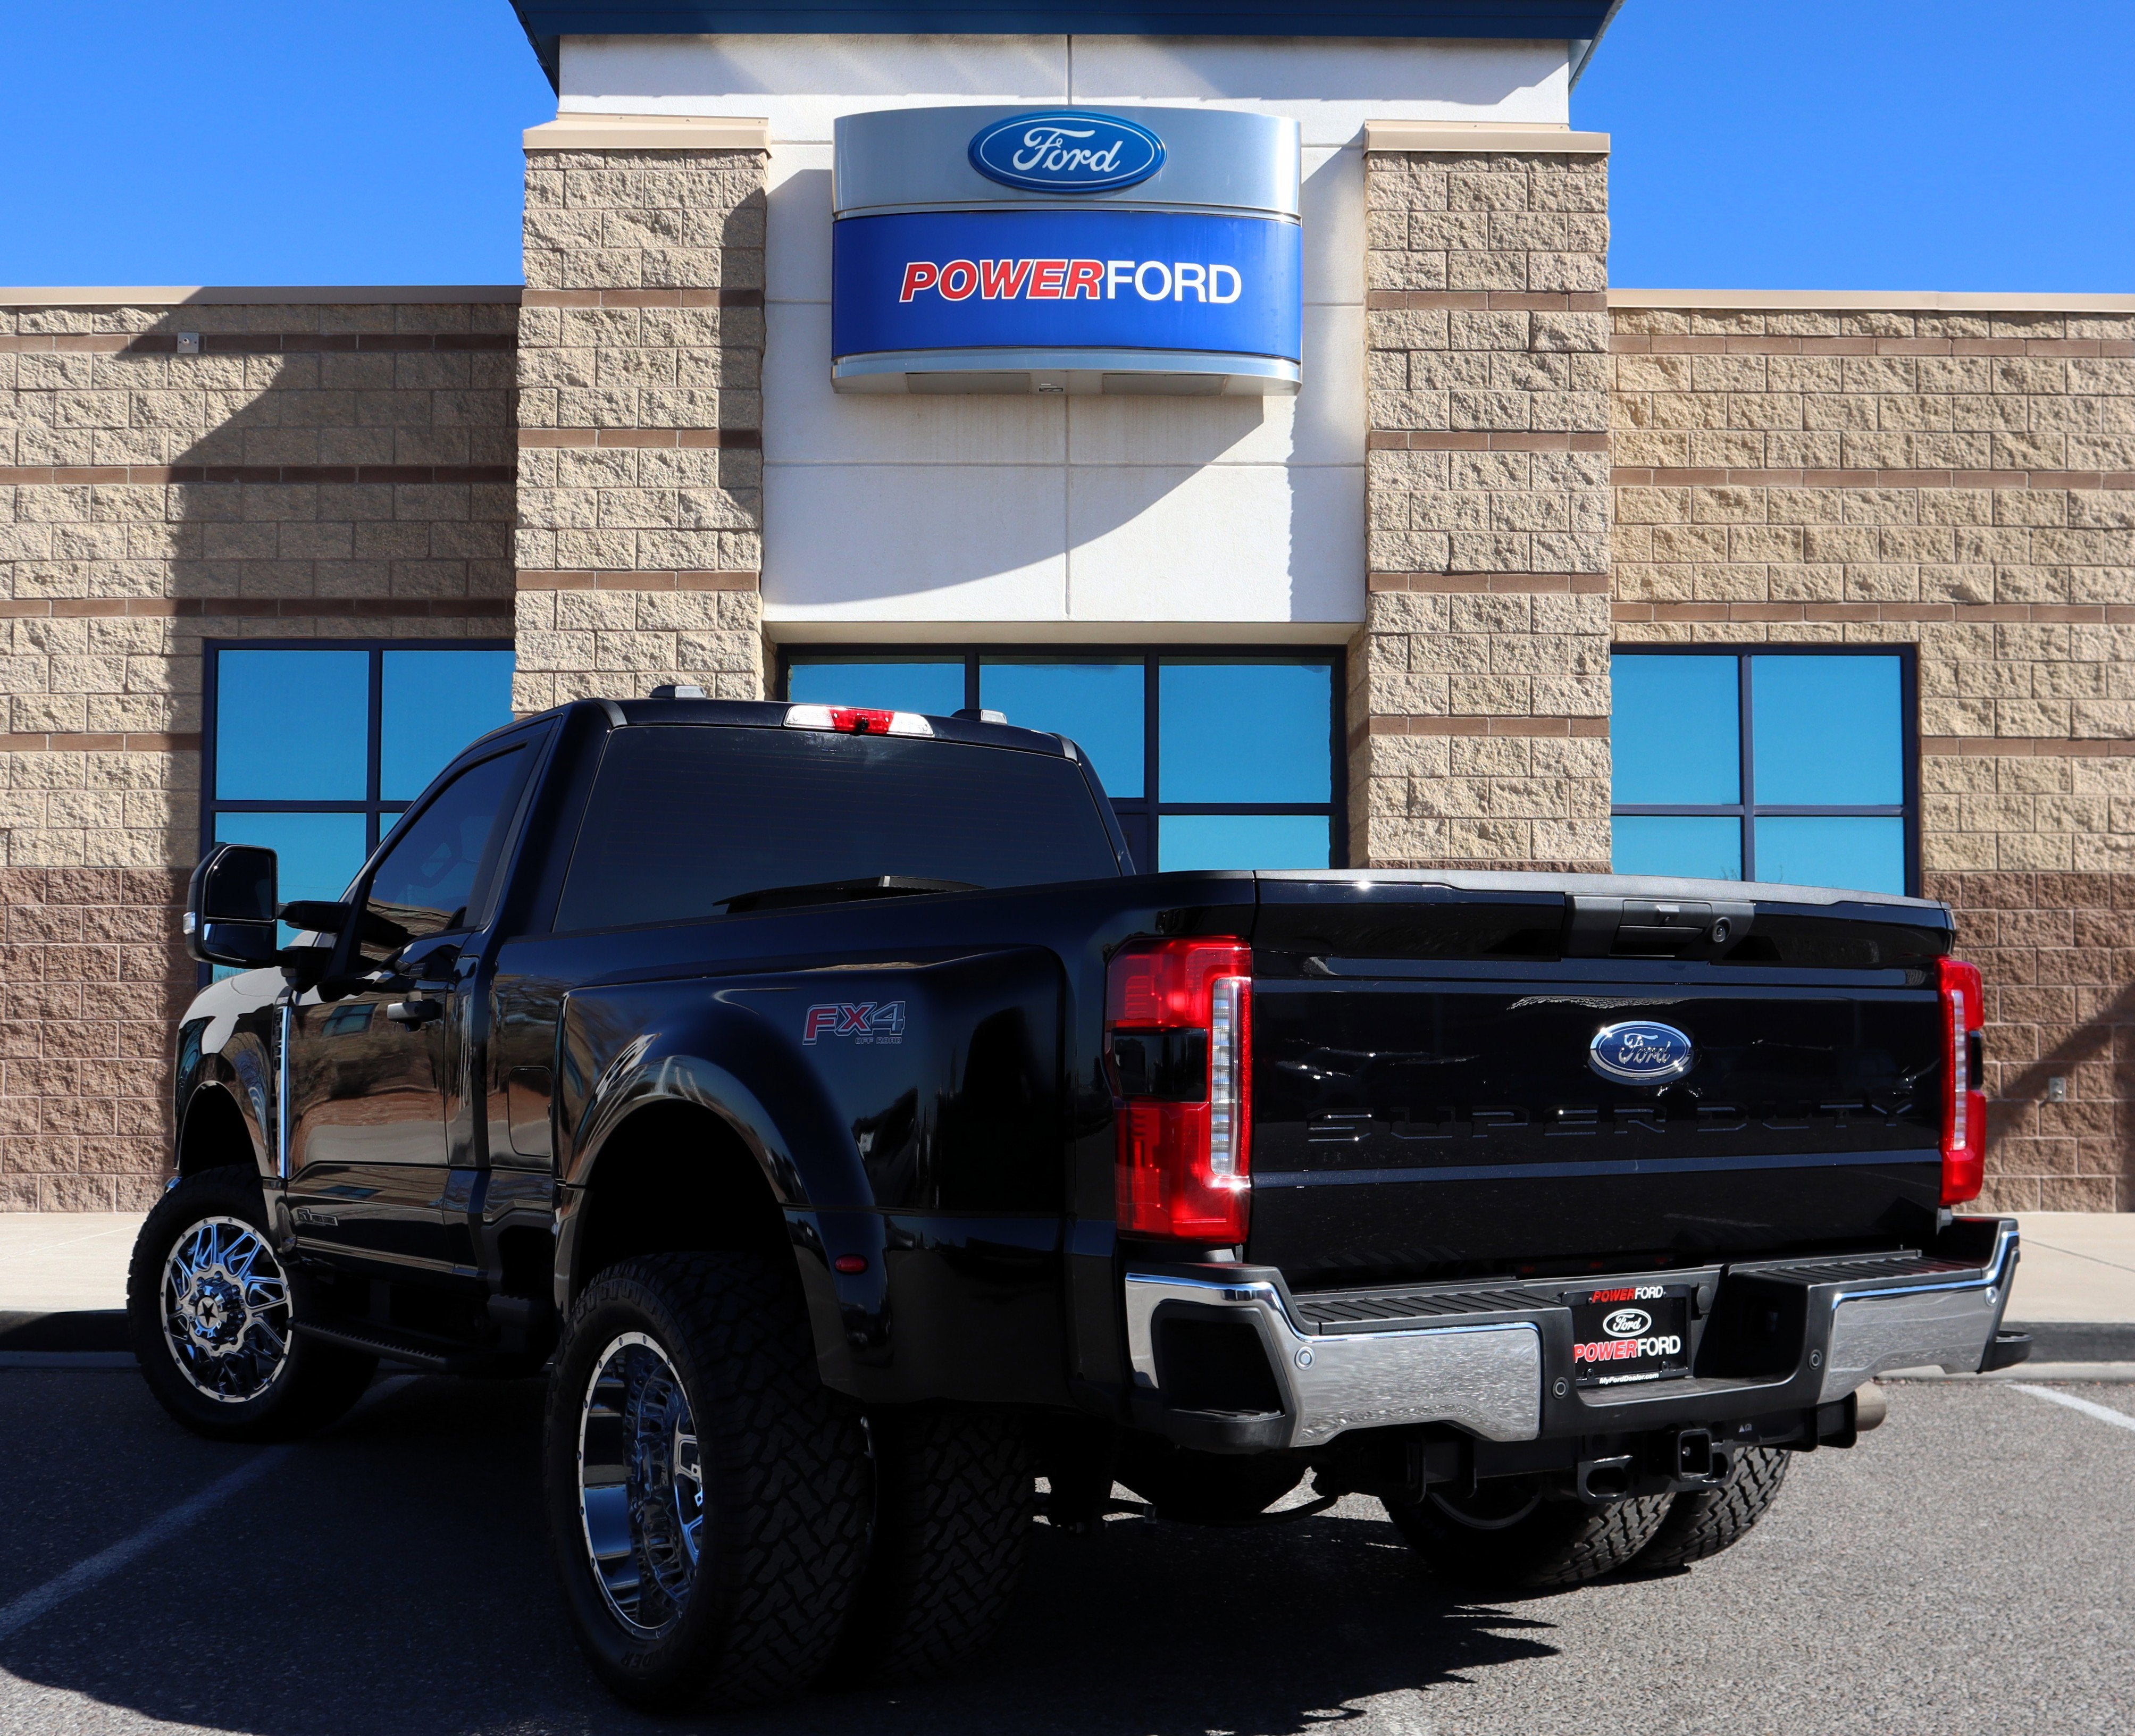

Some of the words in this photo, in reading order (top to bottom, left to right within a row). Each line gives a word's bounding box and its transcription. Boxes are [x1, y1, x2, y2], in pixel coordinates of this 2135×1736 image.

[1012, 127, 1123, 173] Ford
[802, 1001, 906, 1045] FX4
[1618, 1033, 1671, 1064] Ford
[1306, 1102, 1668, 1142] SUPER
[1697, 1097, 1913, 1134] DUTY
[1612, 1314, 1642, 1331] Ford
[1598, 1372, 1660, 1385] MyFordDealer.com
